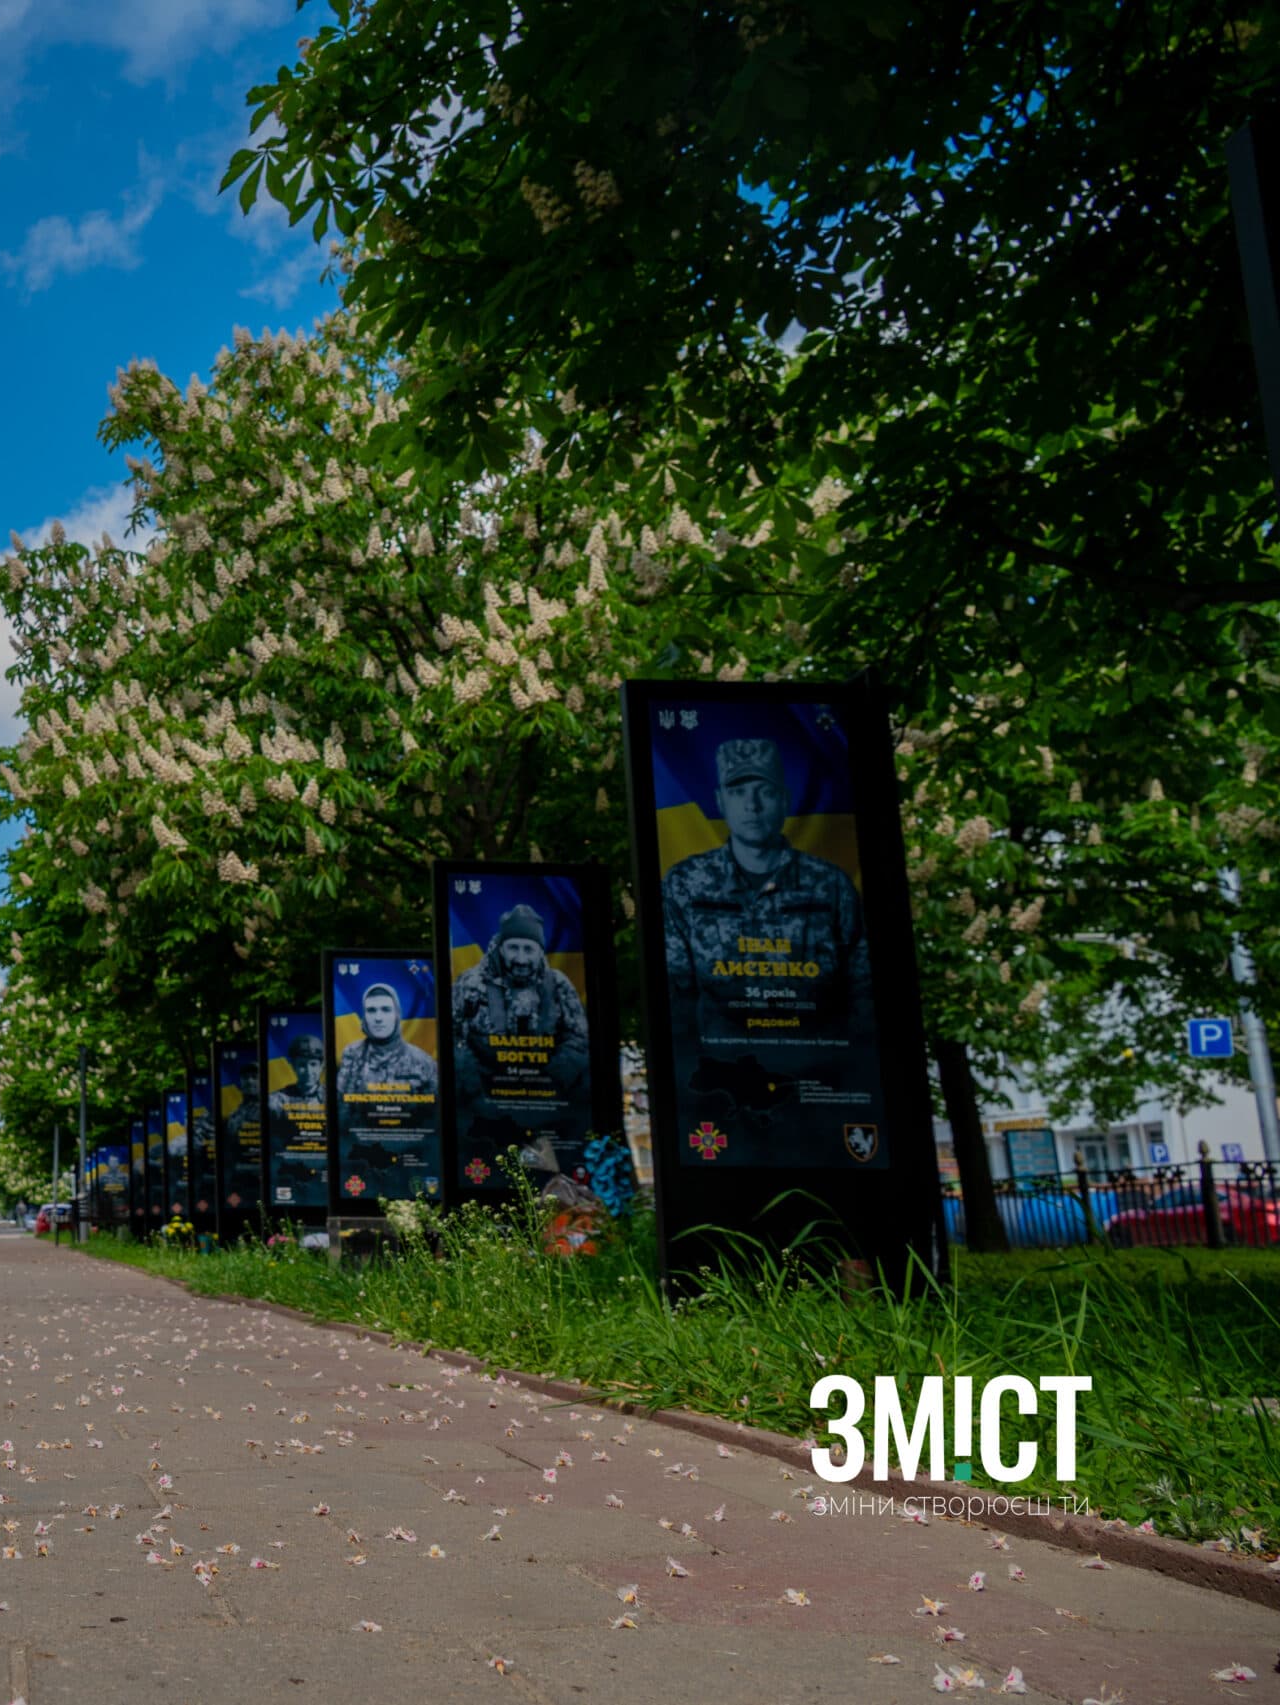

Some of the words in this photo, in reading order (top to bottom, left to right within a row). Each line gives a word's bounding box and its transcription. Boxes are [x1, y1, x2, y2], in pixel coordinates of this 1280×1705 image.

[737, 937, 792, 954] ІВАН
[712, 960, 820, 978] ЛИСЕНКО
[1199, 1024, 1223, 1052] P
[496, 1051, 549, 1064] БОГУН
